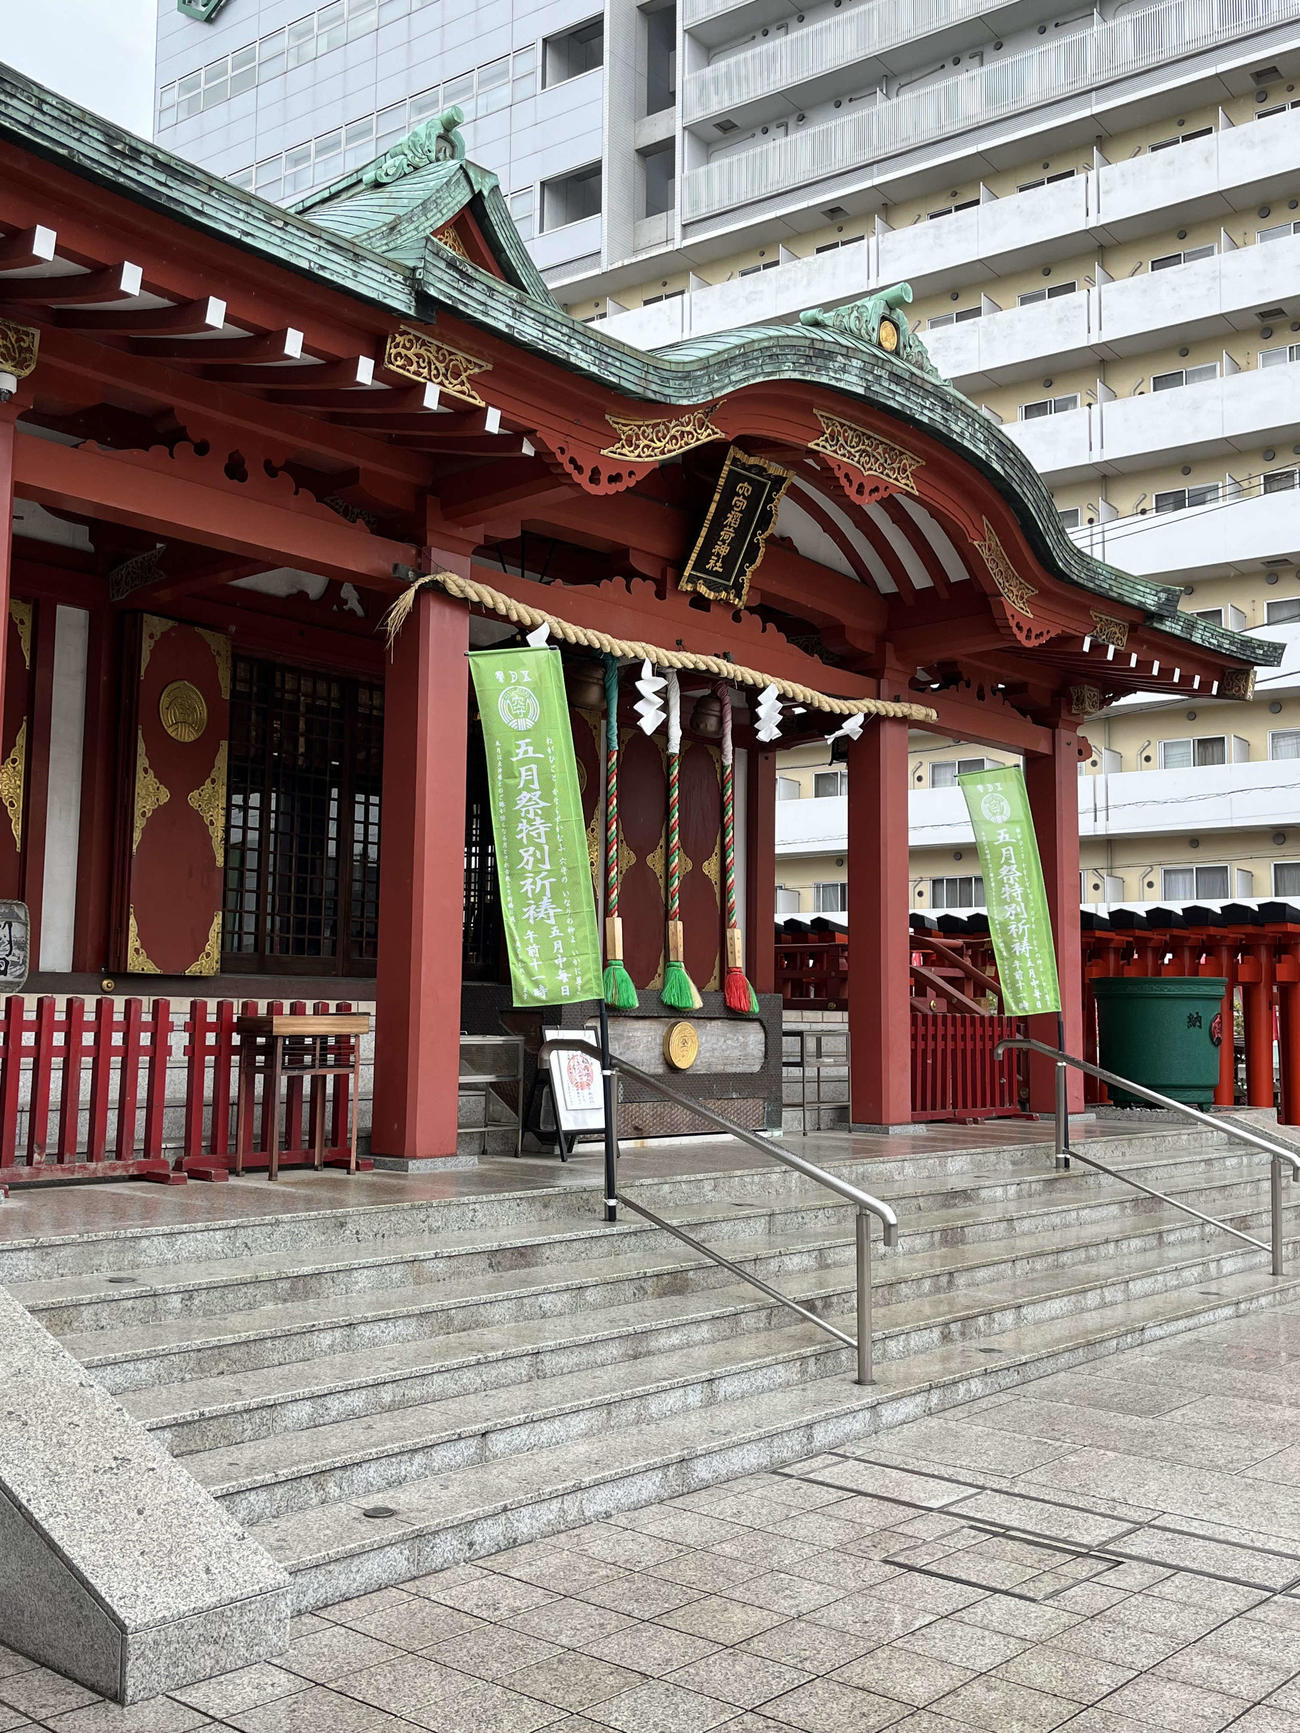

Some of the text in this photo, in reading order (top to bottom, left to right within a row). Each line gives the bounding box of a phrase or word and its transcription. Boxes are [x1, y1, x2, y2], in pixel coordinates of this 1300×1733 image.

[705, 482, 752, 572] 穴守稲荷神社
[510, 738, 562, 925] 五月祭特別祈祷
[993, 828, 1033, 958] 五月祭特別祈祷
[524, 929, 547, 1000] 午前十一時
[548, 925, 572, 997] 五月中毎日
[1187, 1011, 1203, 1029] 納
